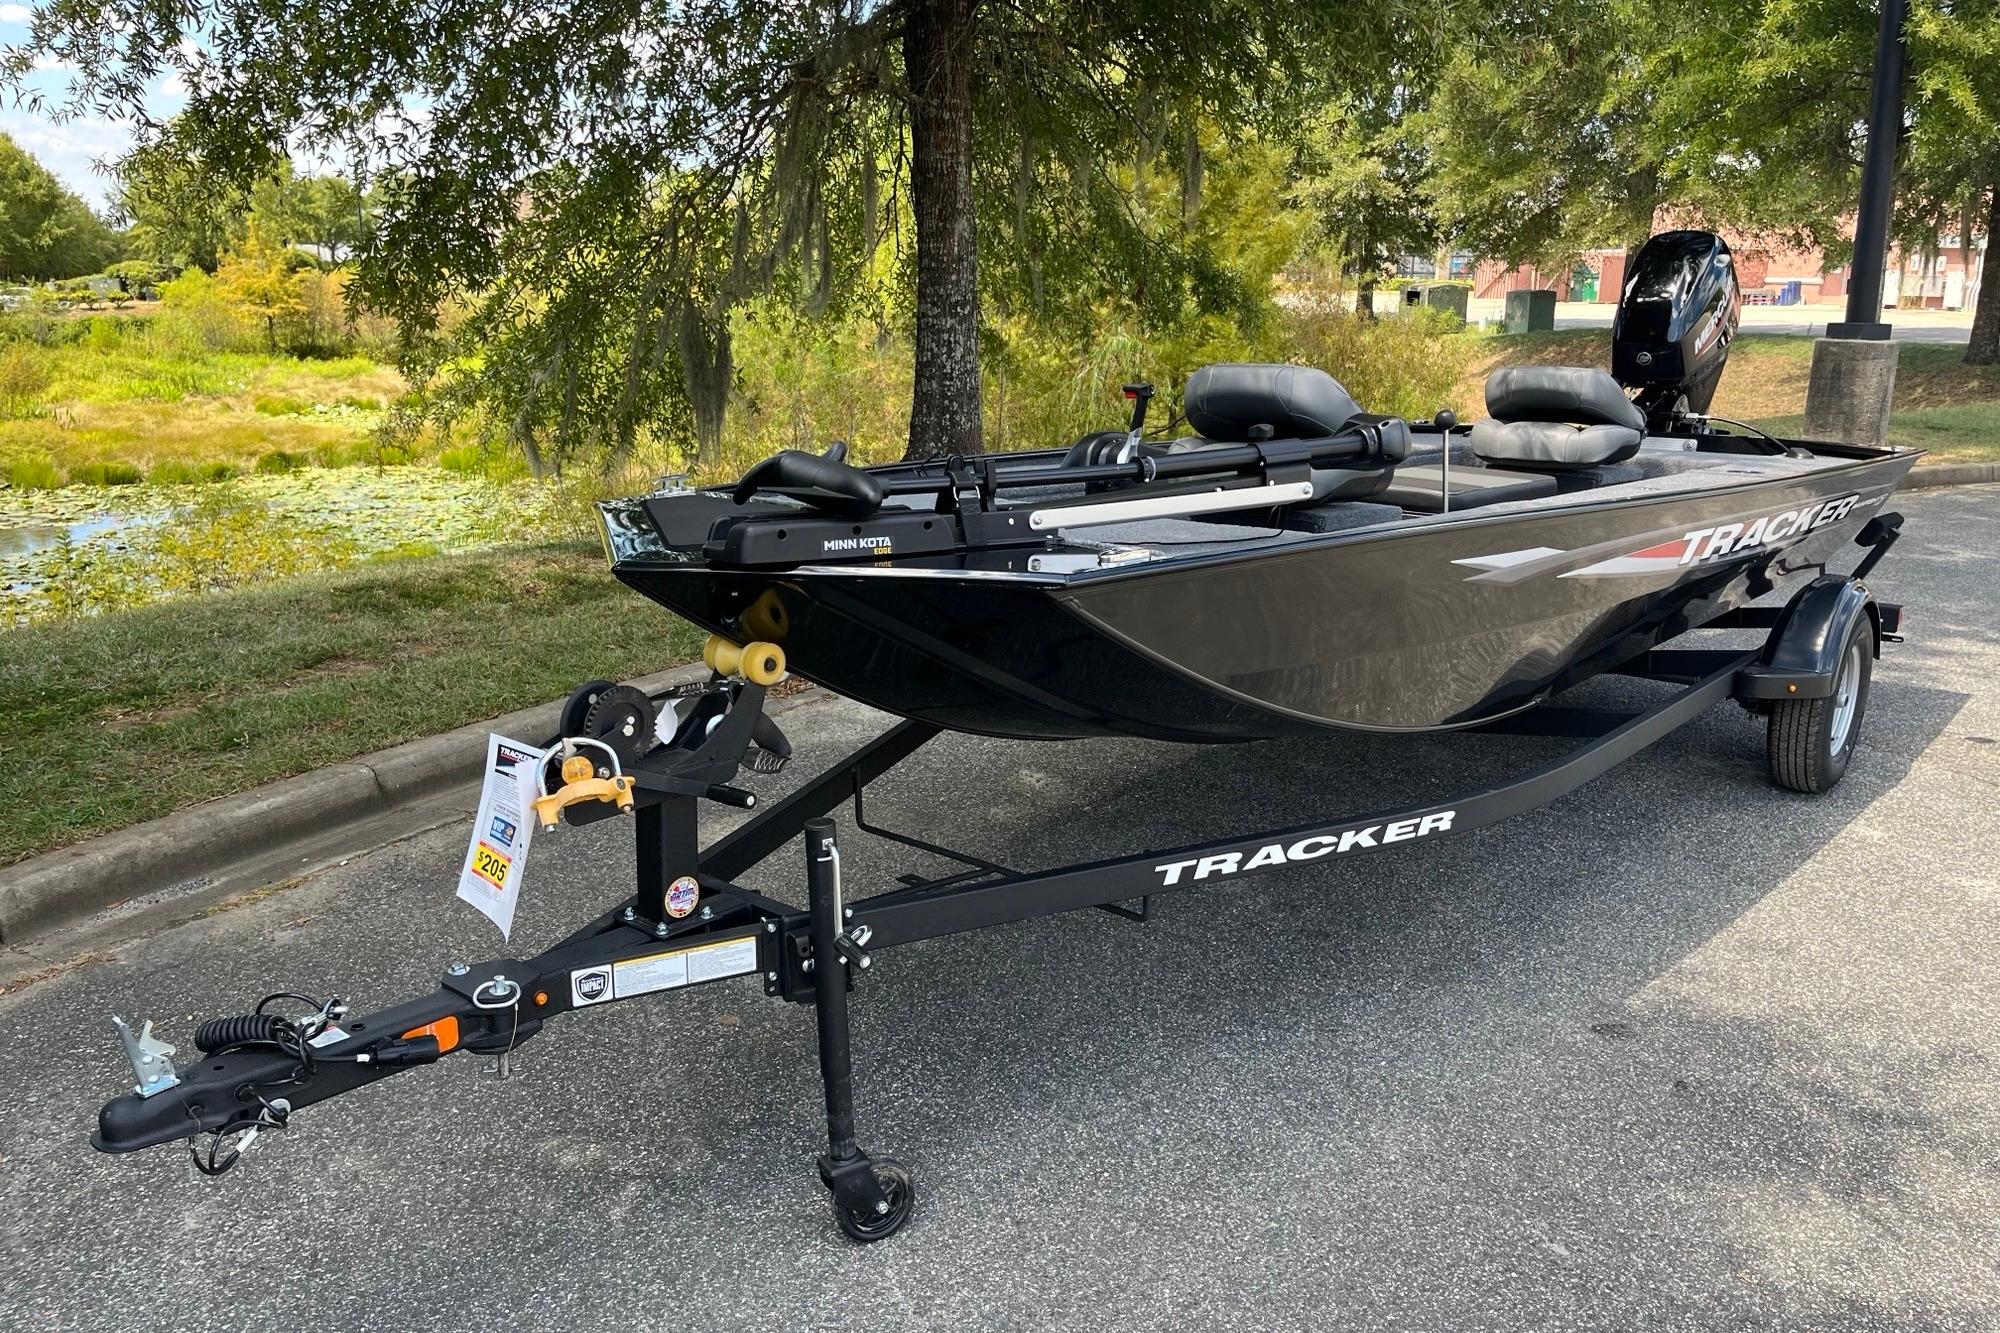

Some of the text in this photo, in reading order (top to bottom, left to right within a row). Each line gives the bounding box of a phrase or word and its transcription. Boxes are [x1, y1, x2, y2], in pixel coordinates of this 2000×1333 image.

[1679, 492, 1860, 565] TRACKER
[824, 537, 891, 551] MINN KOTA
[874, 547, 892, 555] EDGE
[493, 819, 505, 833] VIP
[1154, 810, 1456, 886] TRACKER
[478, 851, 507, 882] $205
[581, 979, 604, 993] IMPACT
